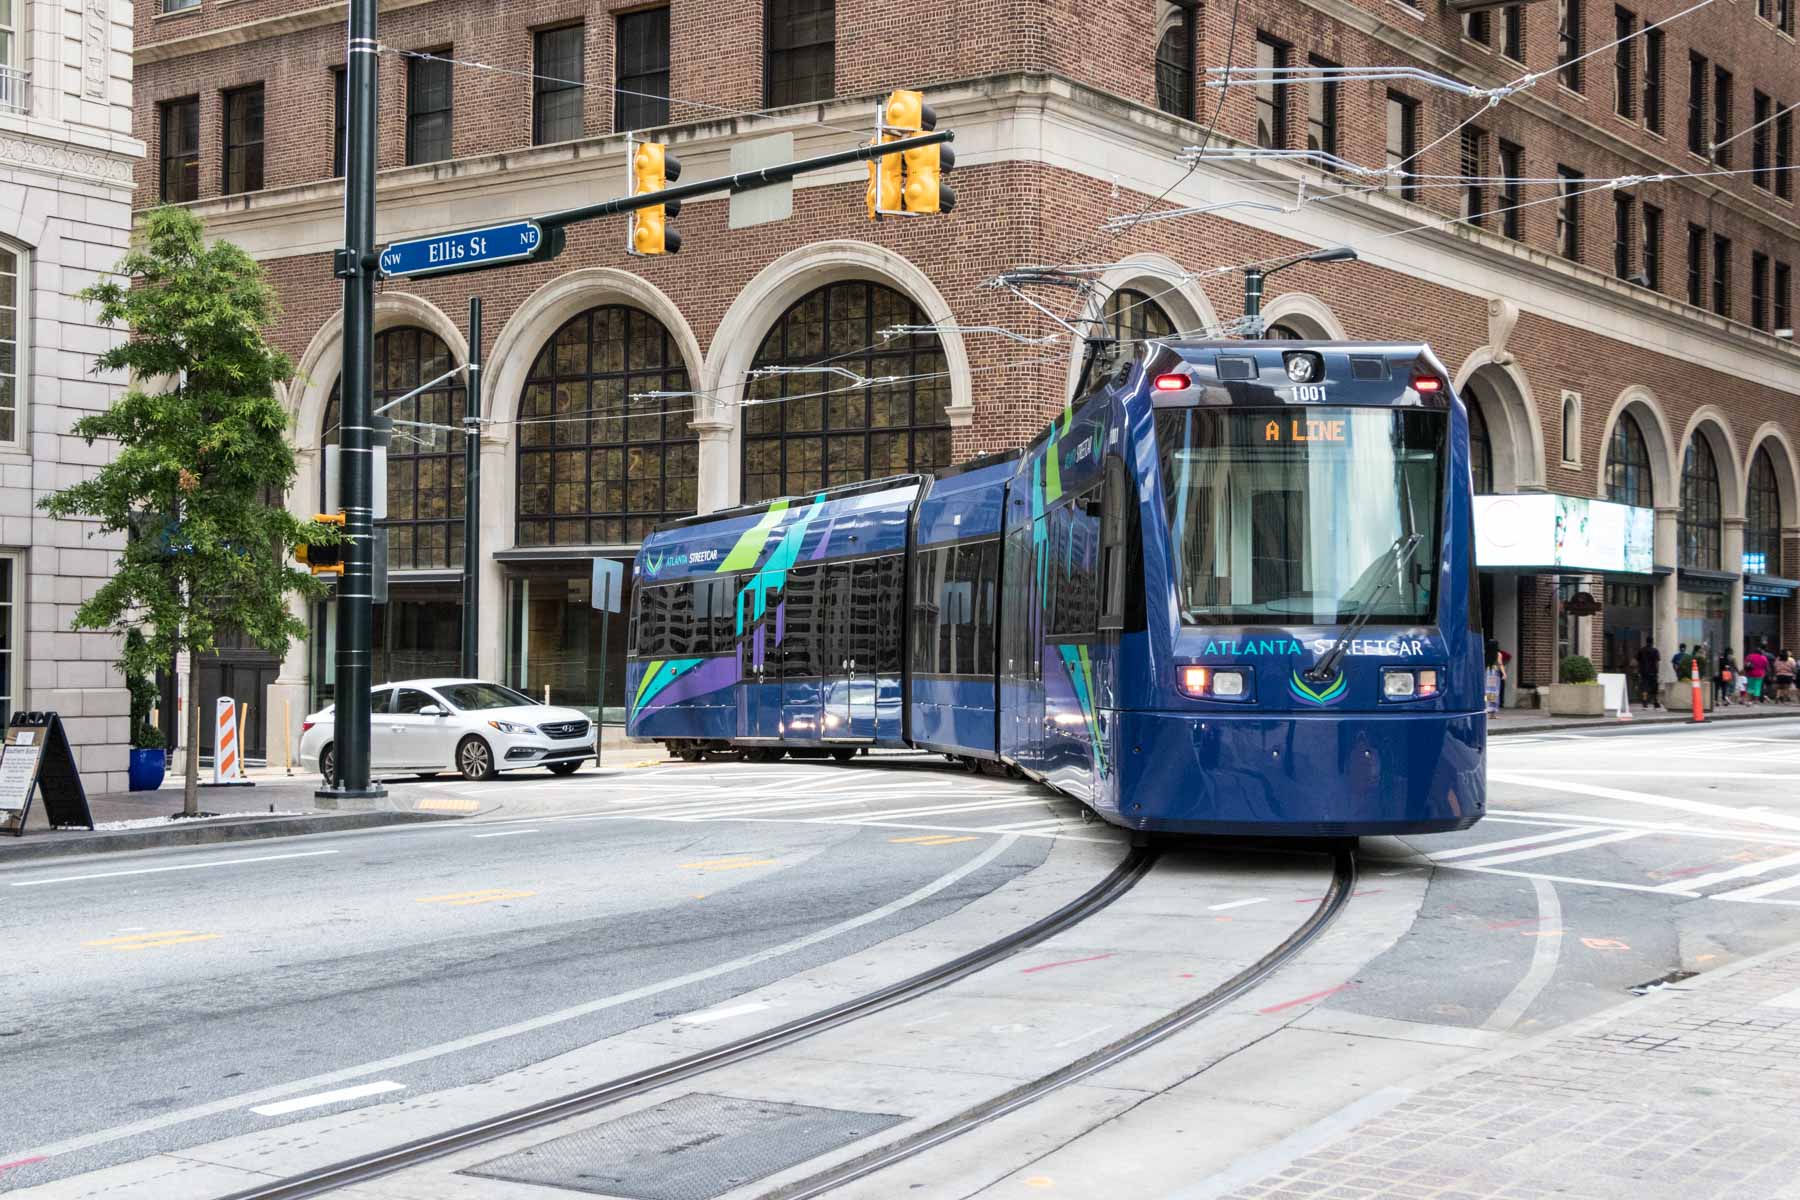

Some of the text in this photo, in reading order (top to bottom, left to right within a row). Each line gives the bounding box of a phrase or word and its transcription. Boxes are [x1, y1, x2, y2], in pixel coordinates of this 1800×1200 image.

[519, 230, 536, 245] NE
[428, 236, 487, 263] Ellis St
[384, 253, 401, 267] NW
[1291, 386, 1327, 401] 1001
[1265, 420, 1345, 441] A LINE
[689, 549, 718, 565] STREETCAR
[1204, 640, 1303, 656] ATLANTA
